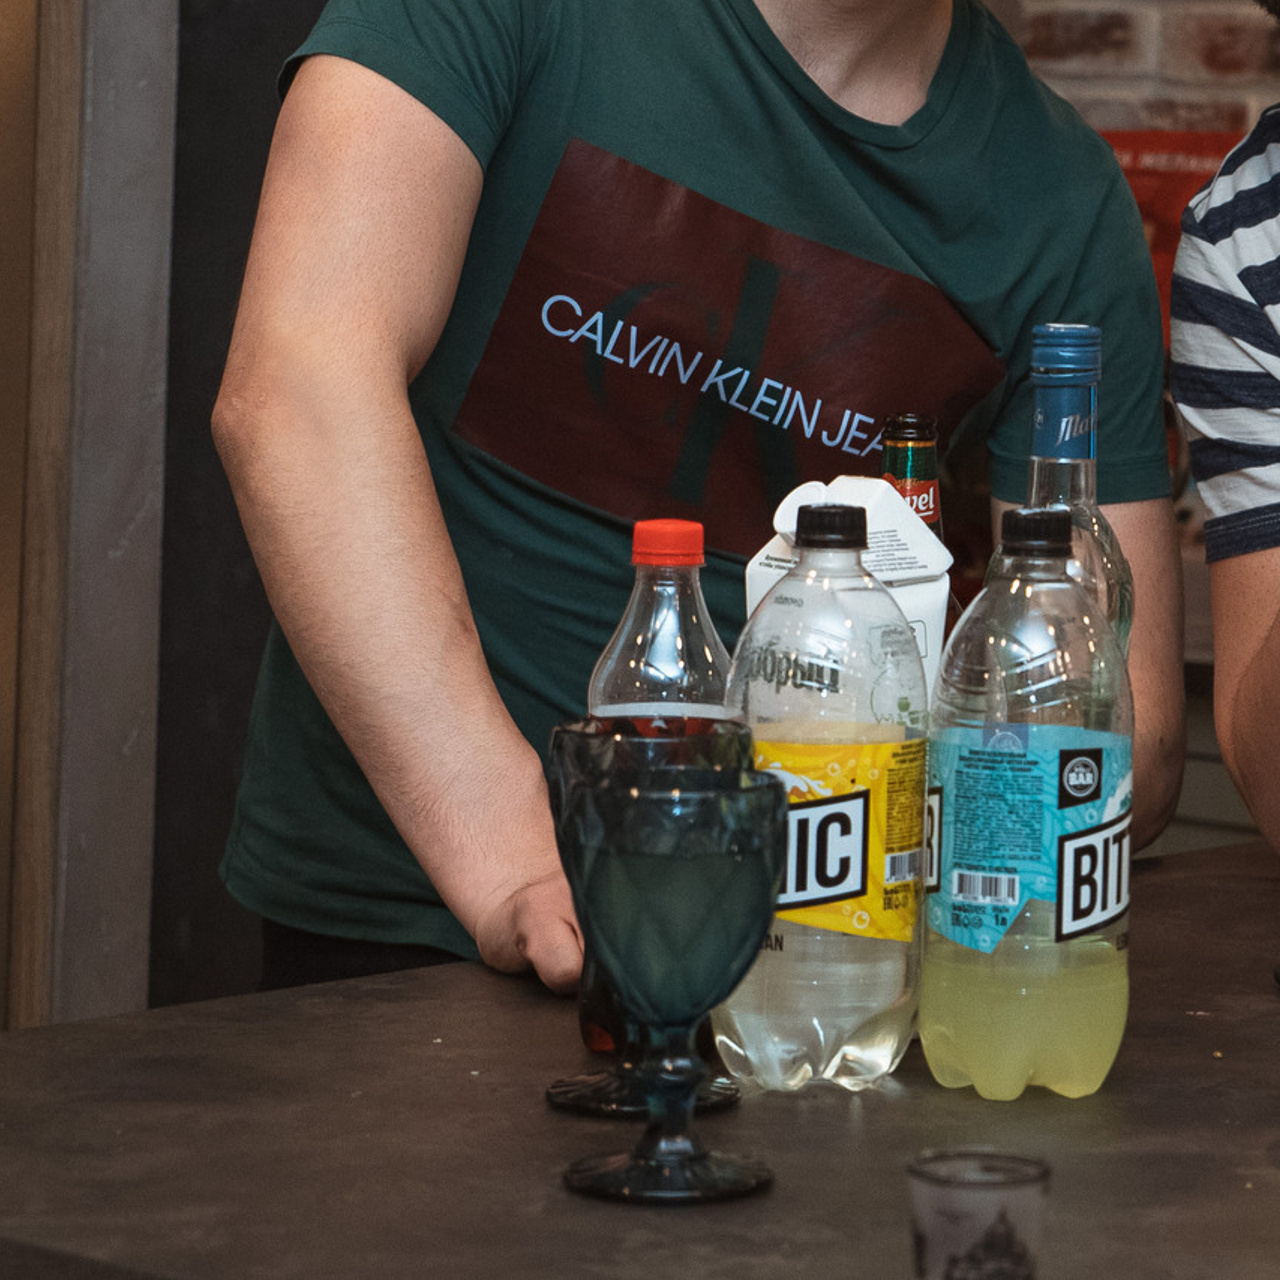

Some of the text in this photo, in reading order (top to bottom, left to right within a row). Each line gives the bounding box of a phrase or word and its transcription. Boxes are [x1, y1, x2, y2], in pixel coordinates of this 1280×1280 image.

[541, 294, 886, 457] CALVIN KLEIN JEA
[778, 811, 852, 893] IC
[764, 934, 784, 951] AN
